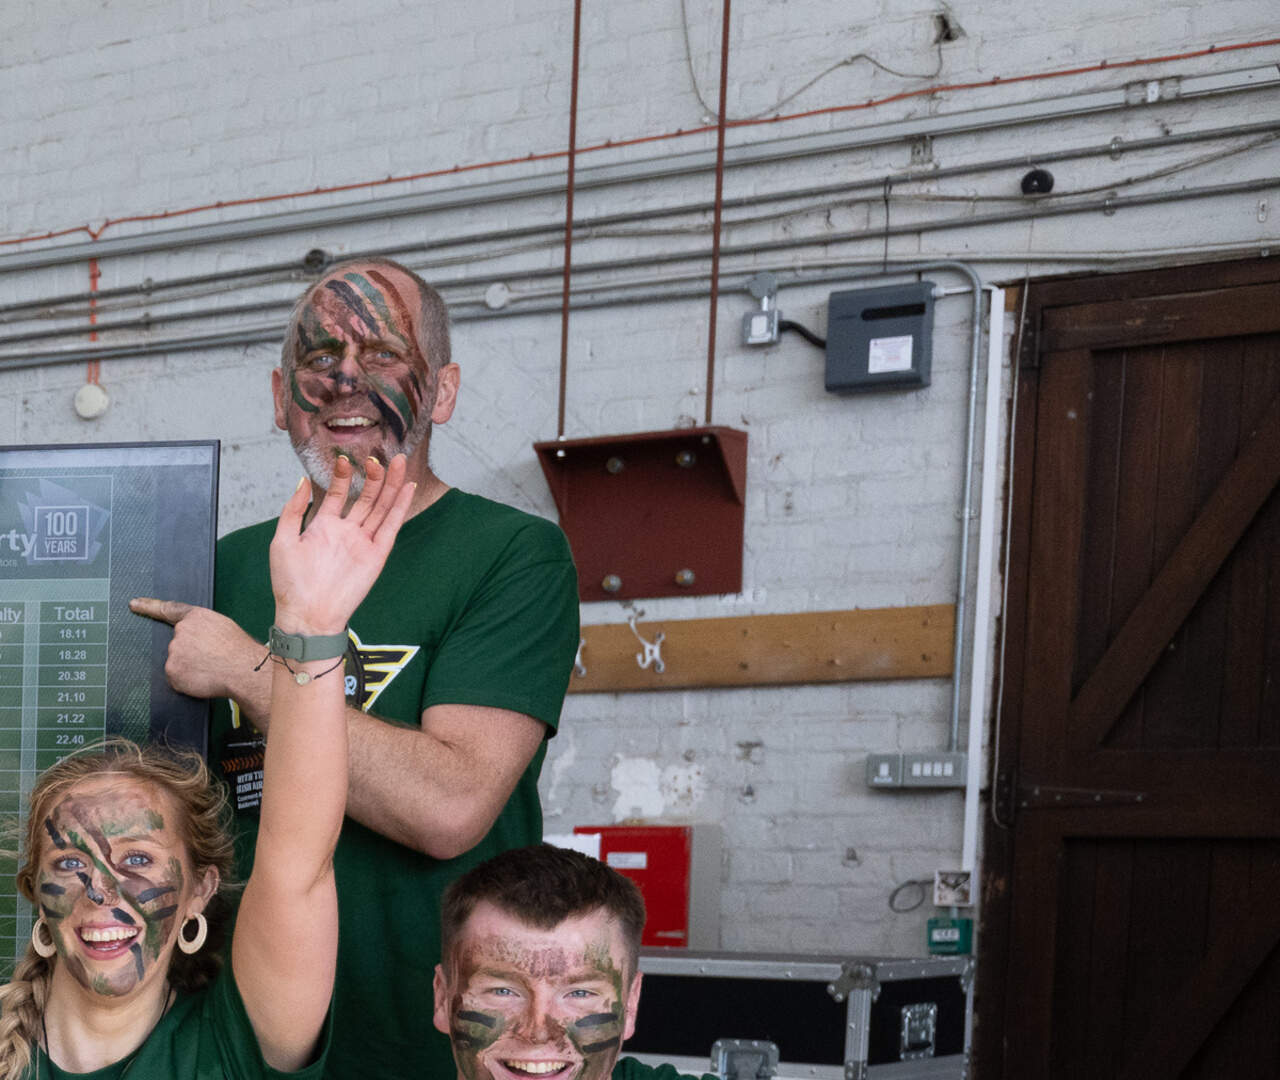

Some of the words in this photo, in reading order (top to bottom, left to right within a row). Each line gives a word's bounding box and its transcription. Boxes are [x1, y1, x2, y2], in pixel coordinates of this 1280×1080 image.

[44, 511, 78, 535] 100
[44, 540, 77, 554] YEARS
[54, 606, 94, 621] Total
[58, 629, 87, 639] 18.11
[58, 650, 87, 660] 18.28
[57, 671, 86, 681] 20.38
[57, 692, 86, 702] 21.10
[56, 714, 85, 724] 21.22
[56, 735, 85, 745] 22.40
